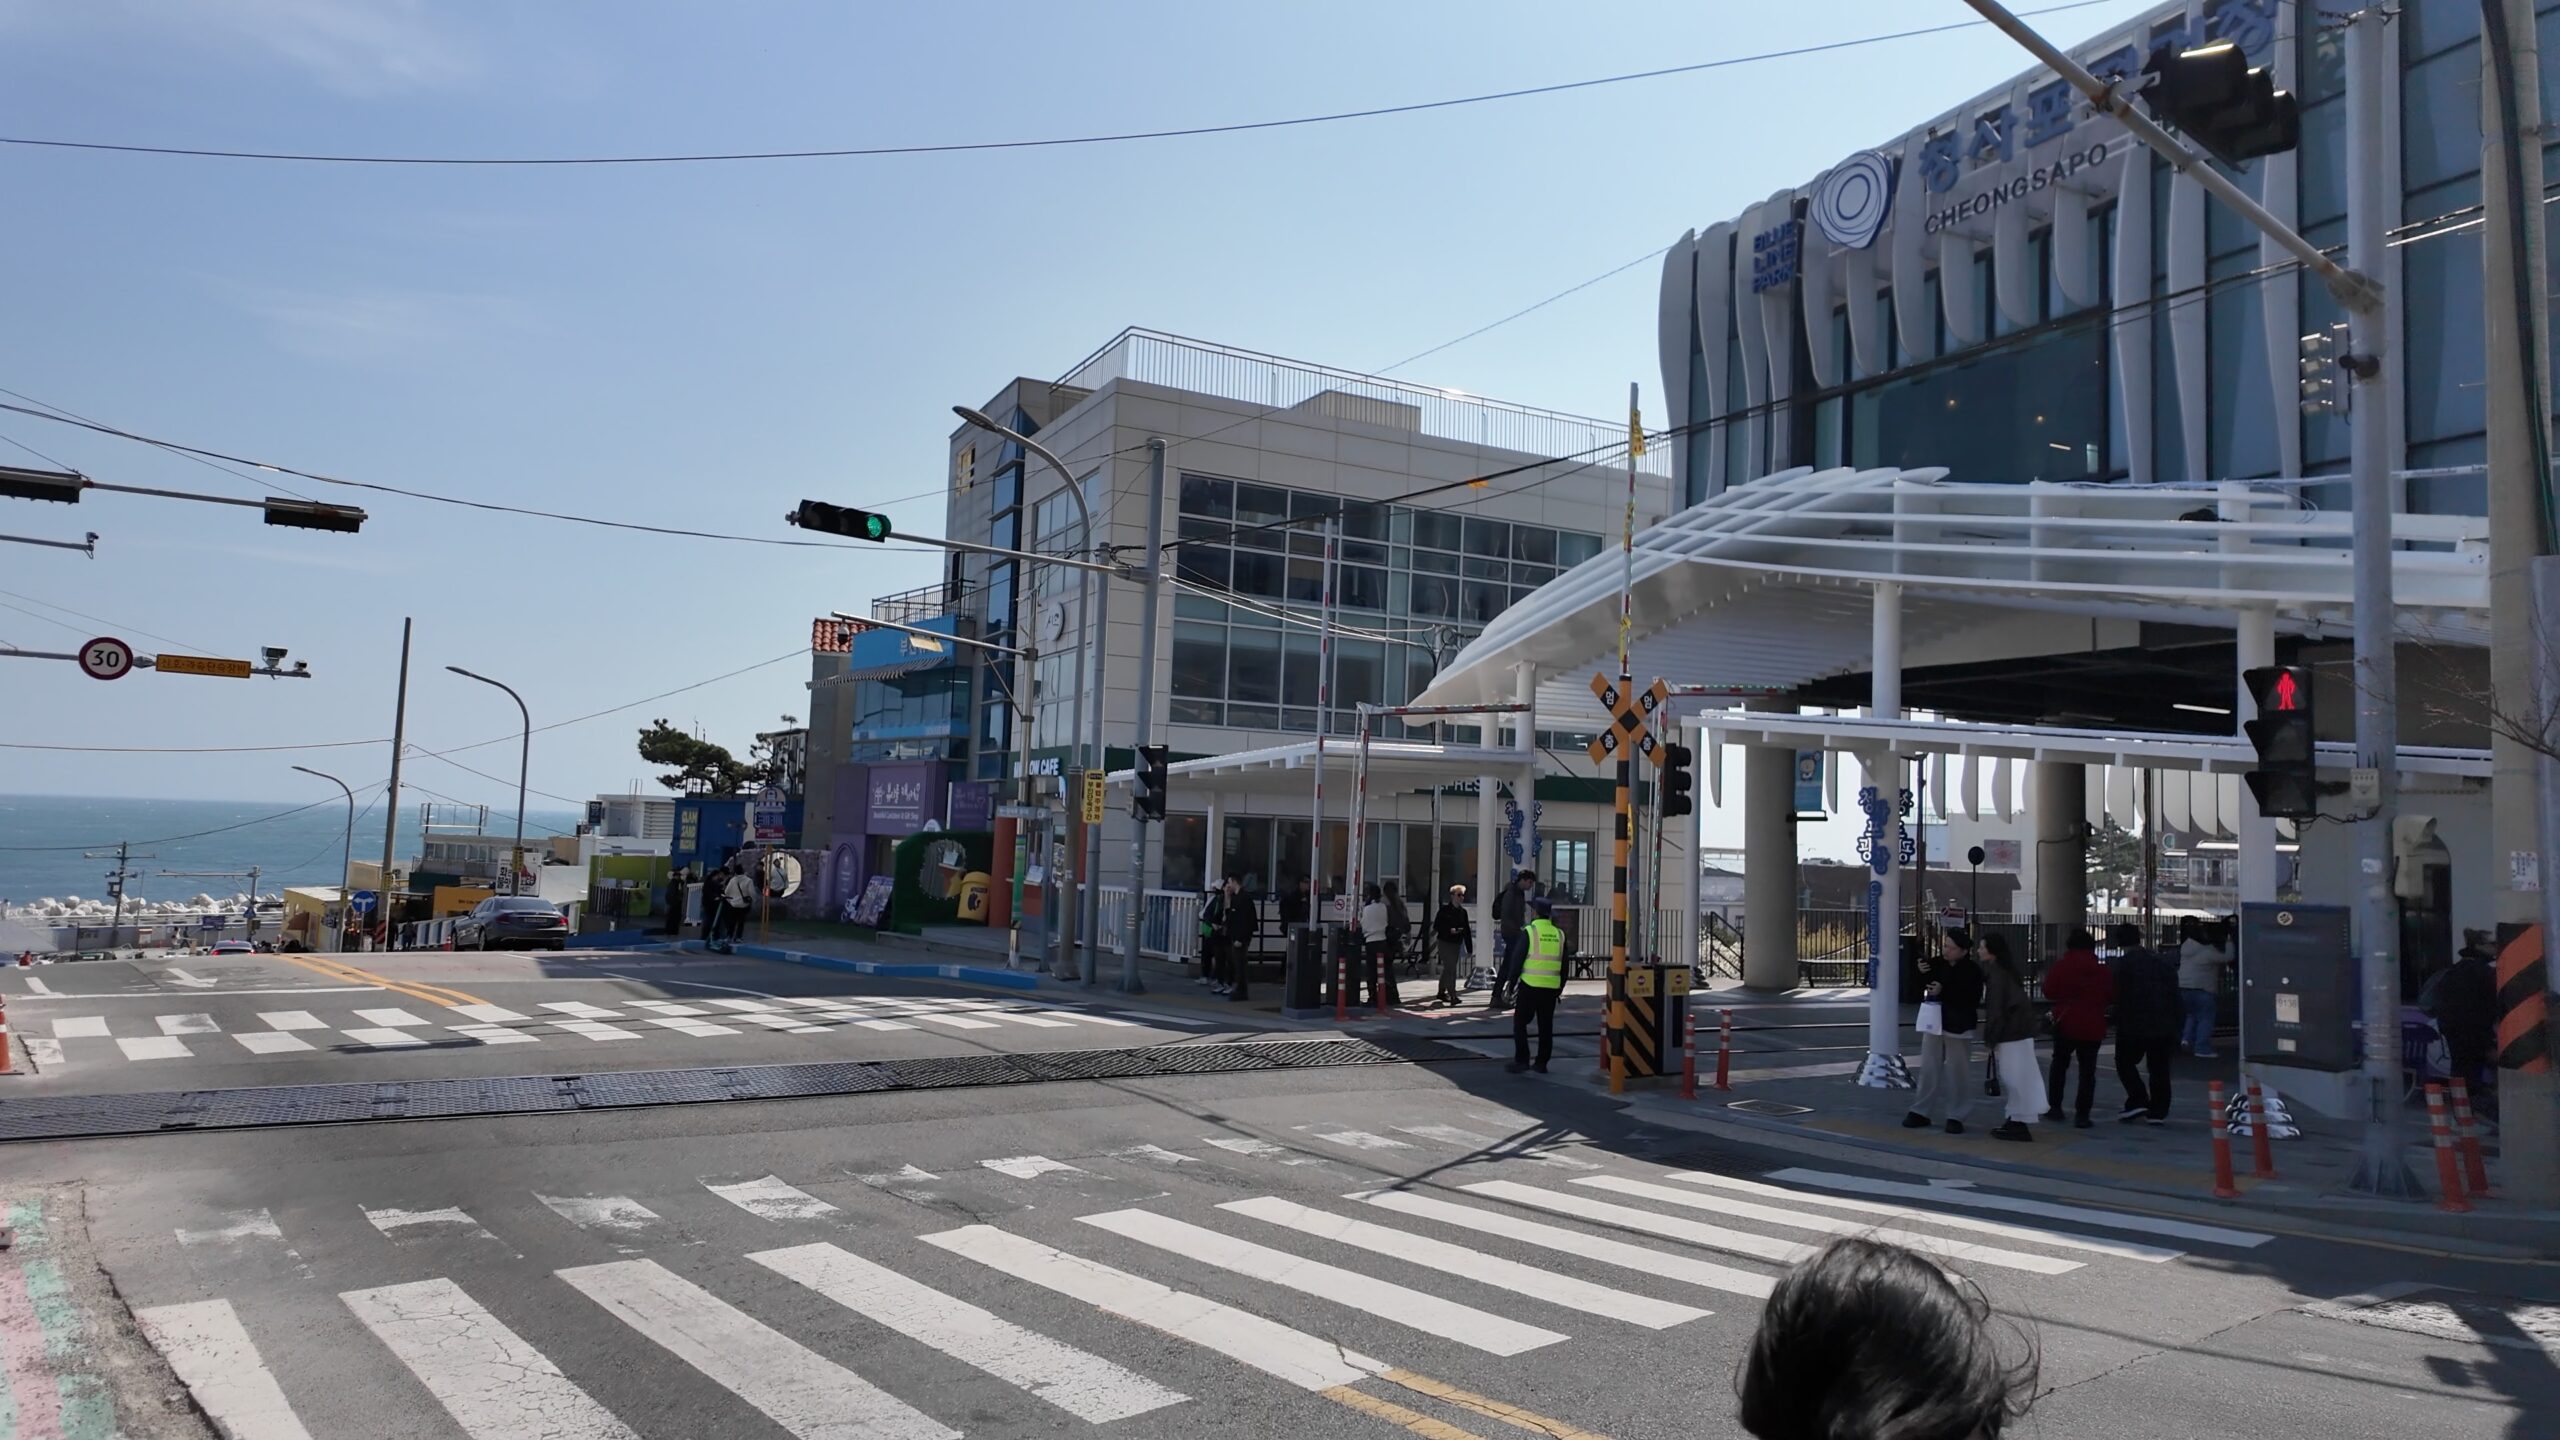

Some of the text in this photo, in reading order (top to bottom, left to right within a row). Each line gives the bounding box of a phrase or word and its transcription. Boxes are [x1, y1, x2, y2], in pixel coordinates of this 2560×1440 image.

[1924, 142, 2108, 236] CHEONGSAPO
[1753, 220, 1797, 253] BLUE
[1753, 240, 1797, 274] LINE
[1752, 263, 1796, 294] PARK
[92, 649, 120, 668] 30
[1605, 691, 1615, 705] 멈
[1644, 695, 1653, 709] 멈
[1604, 734, 1614, 749] 춤
[1643, 736, 1652, 751] 춤
[1041, 758, 1059, 776] CAFE
